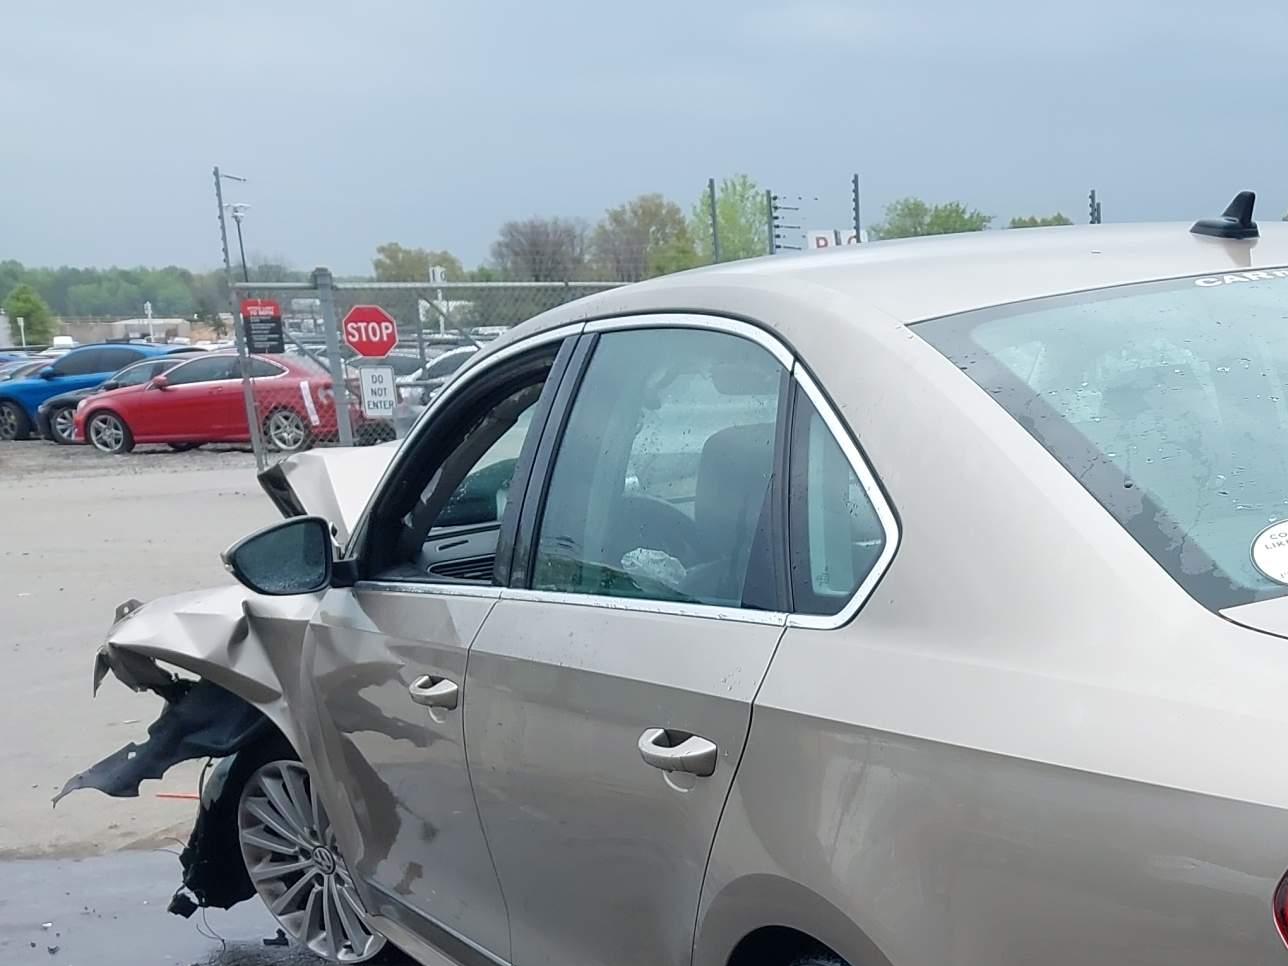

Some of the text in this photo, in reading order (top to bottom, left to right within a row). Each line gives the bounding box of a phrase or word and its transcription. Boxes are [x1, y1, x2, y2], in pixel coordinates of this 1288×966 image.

[347, 321, 393, 342] STOP
[371, 374, 384, 384] DO
[370, 387, 387, 397] NOT
[367, 400, 394, 410] ENTER
